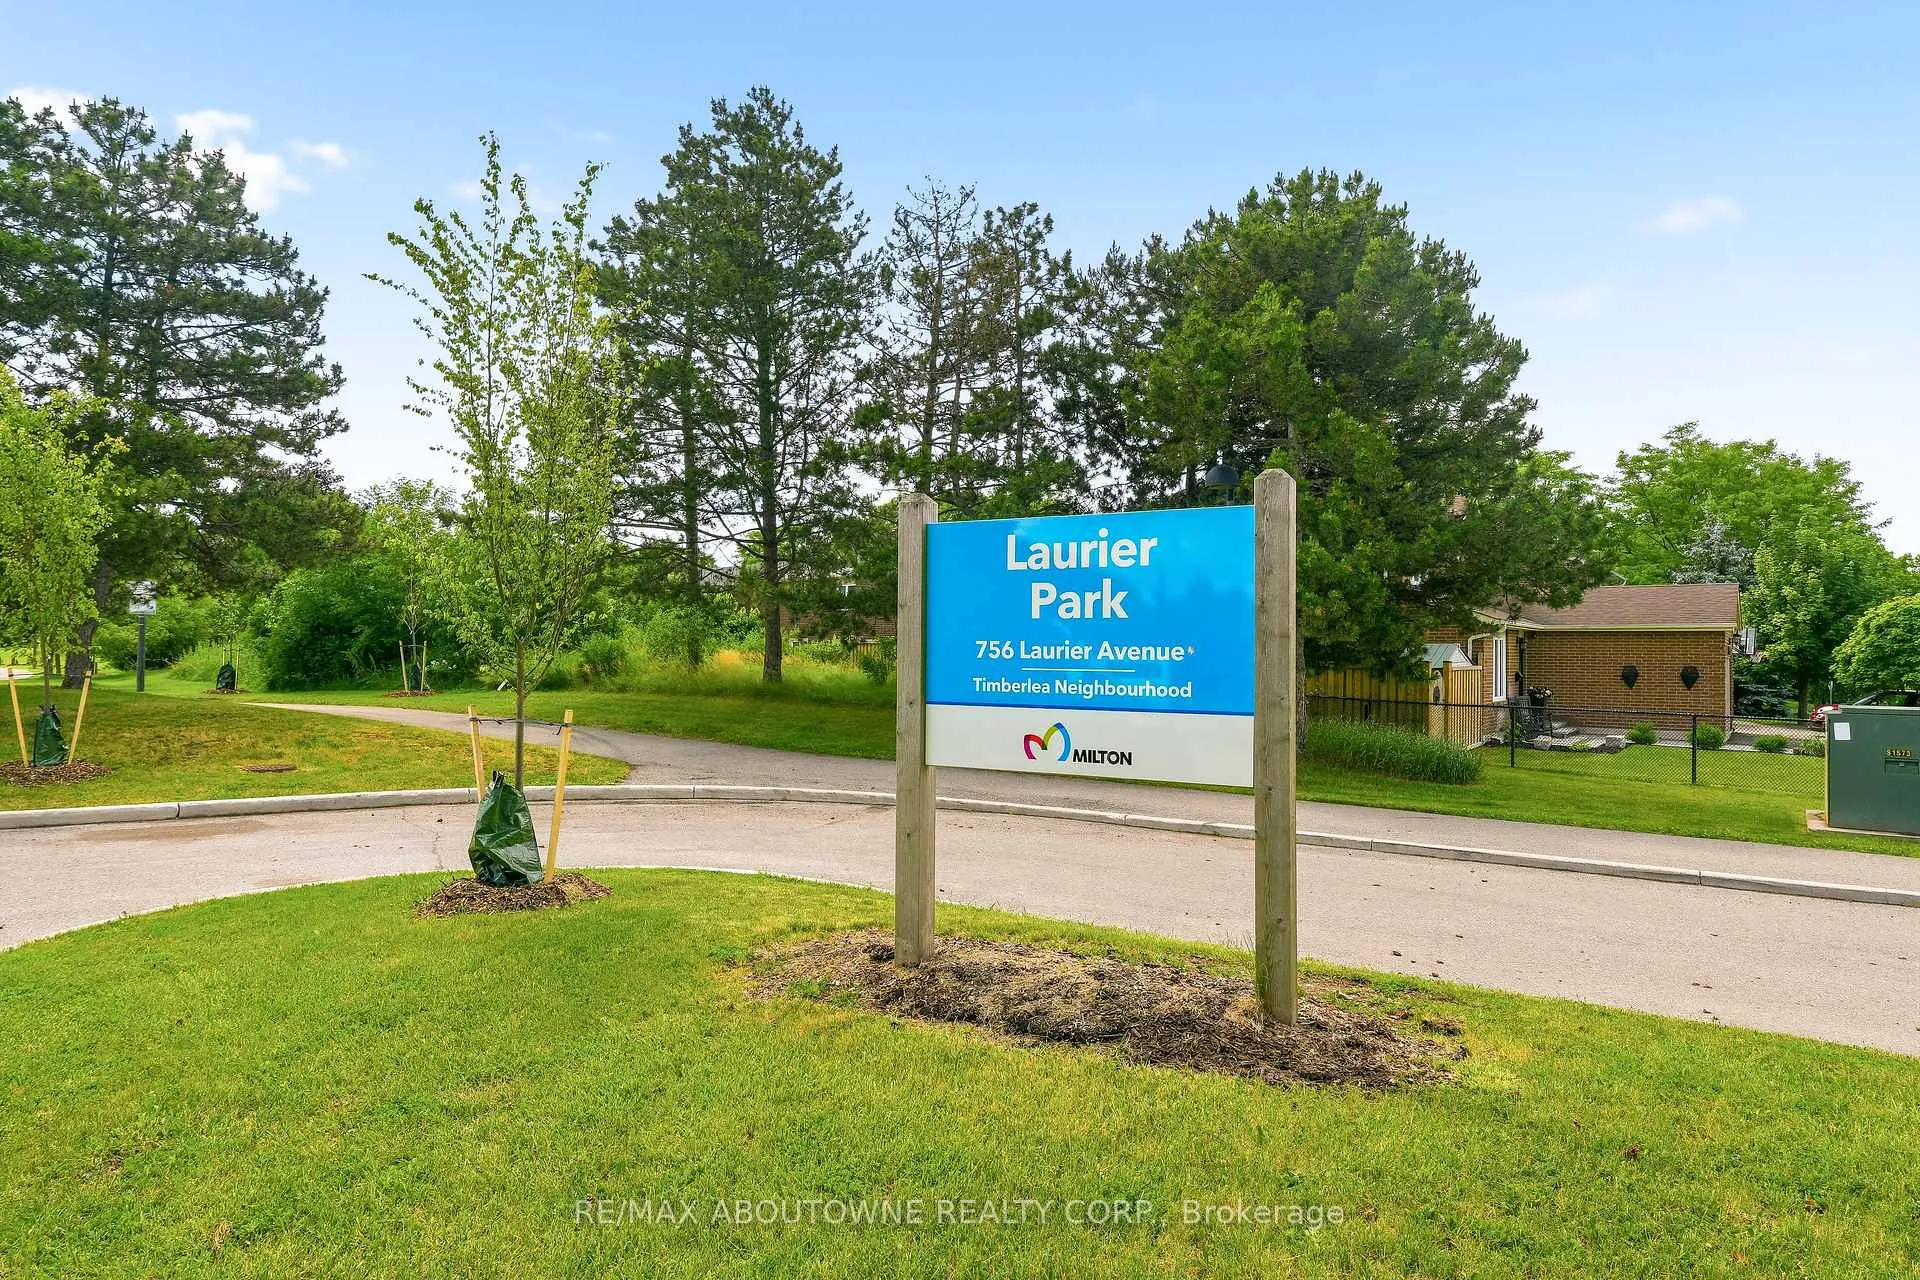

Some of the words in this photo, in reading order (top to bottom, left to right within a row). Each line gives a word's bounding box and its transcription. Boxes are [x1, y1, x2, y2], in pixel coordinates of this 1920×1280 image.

[1006, 528, 1158, 571] Laurier
[1030, 578, 1129, 620] Park
[975, 640, 1014, 660] 756
[1020, 640, 1093, 661] Laurier
[1097, 641, 1185, 662] Avenue
[972, 677, 1051, 695] Timberlea
[1055, 679, 1193, 699] Neighbourhood
[1072, 748, 1133, 766] MILTON
